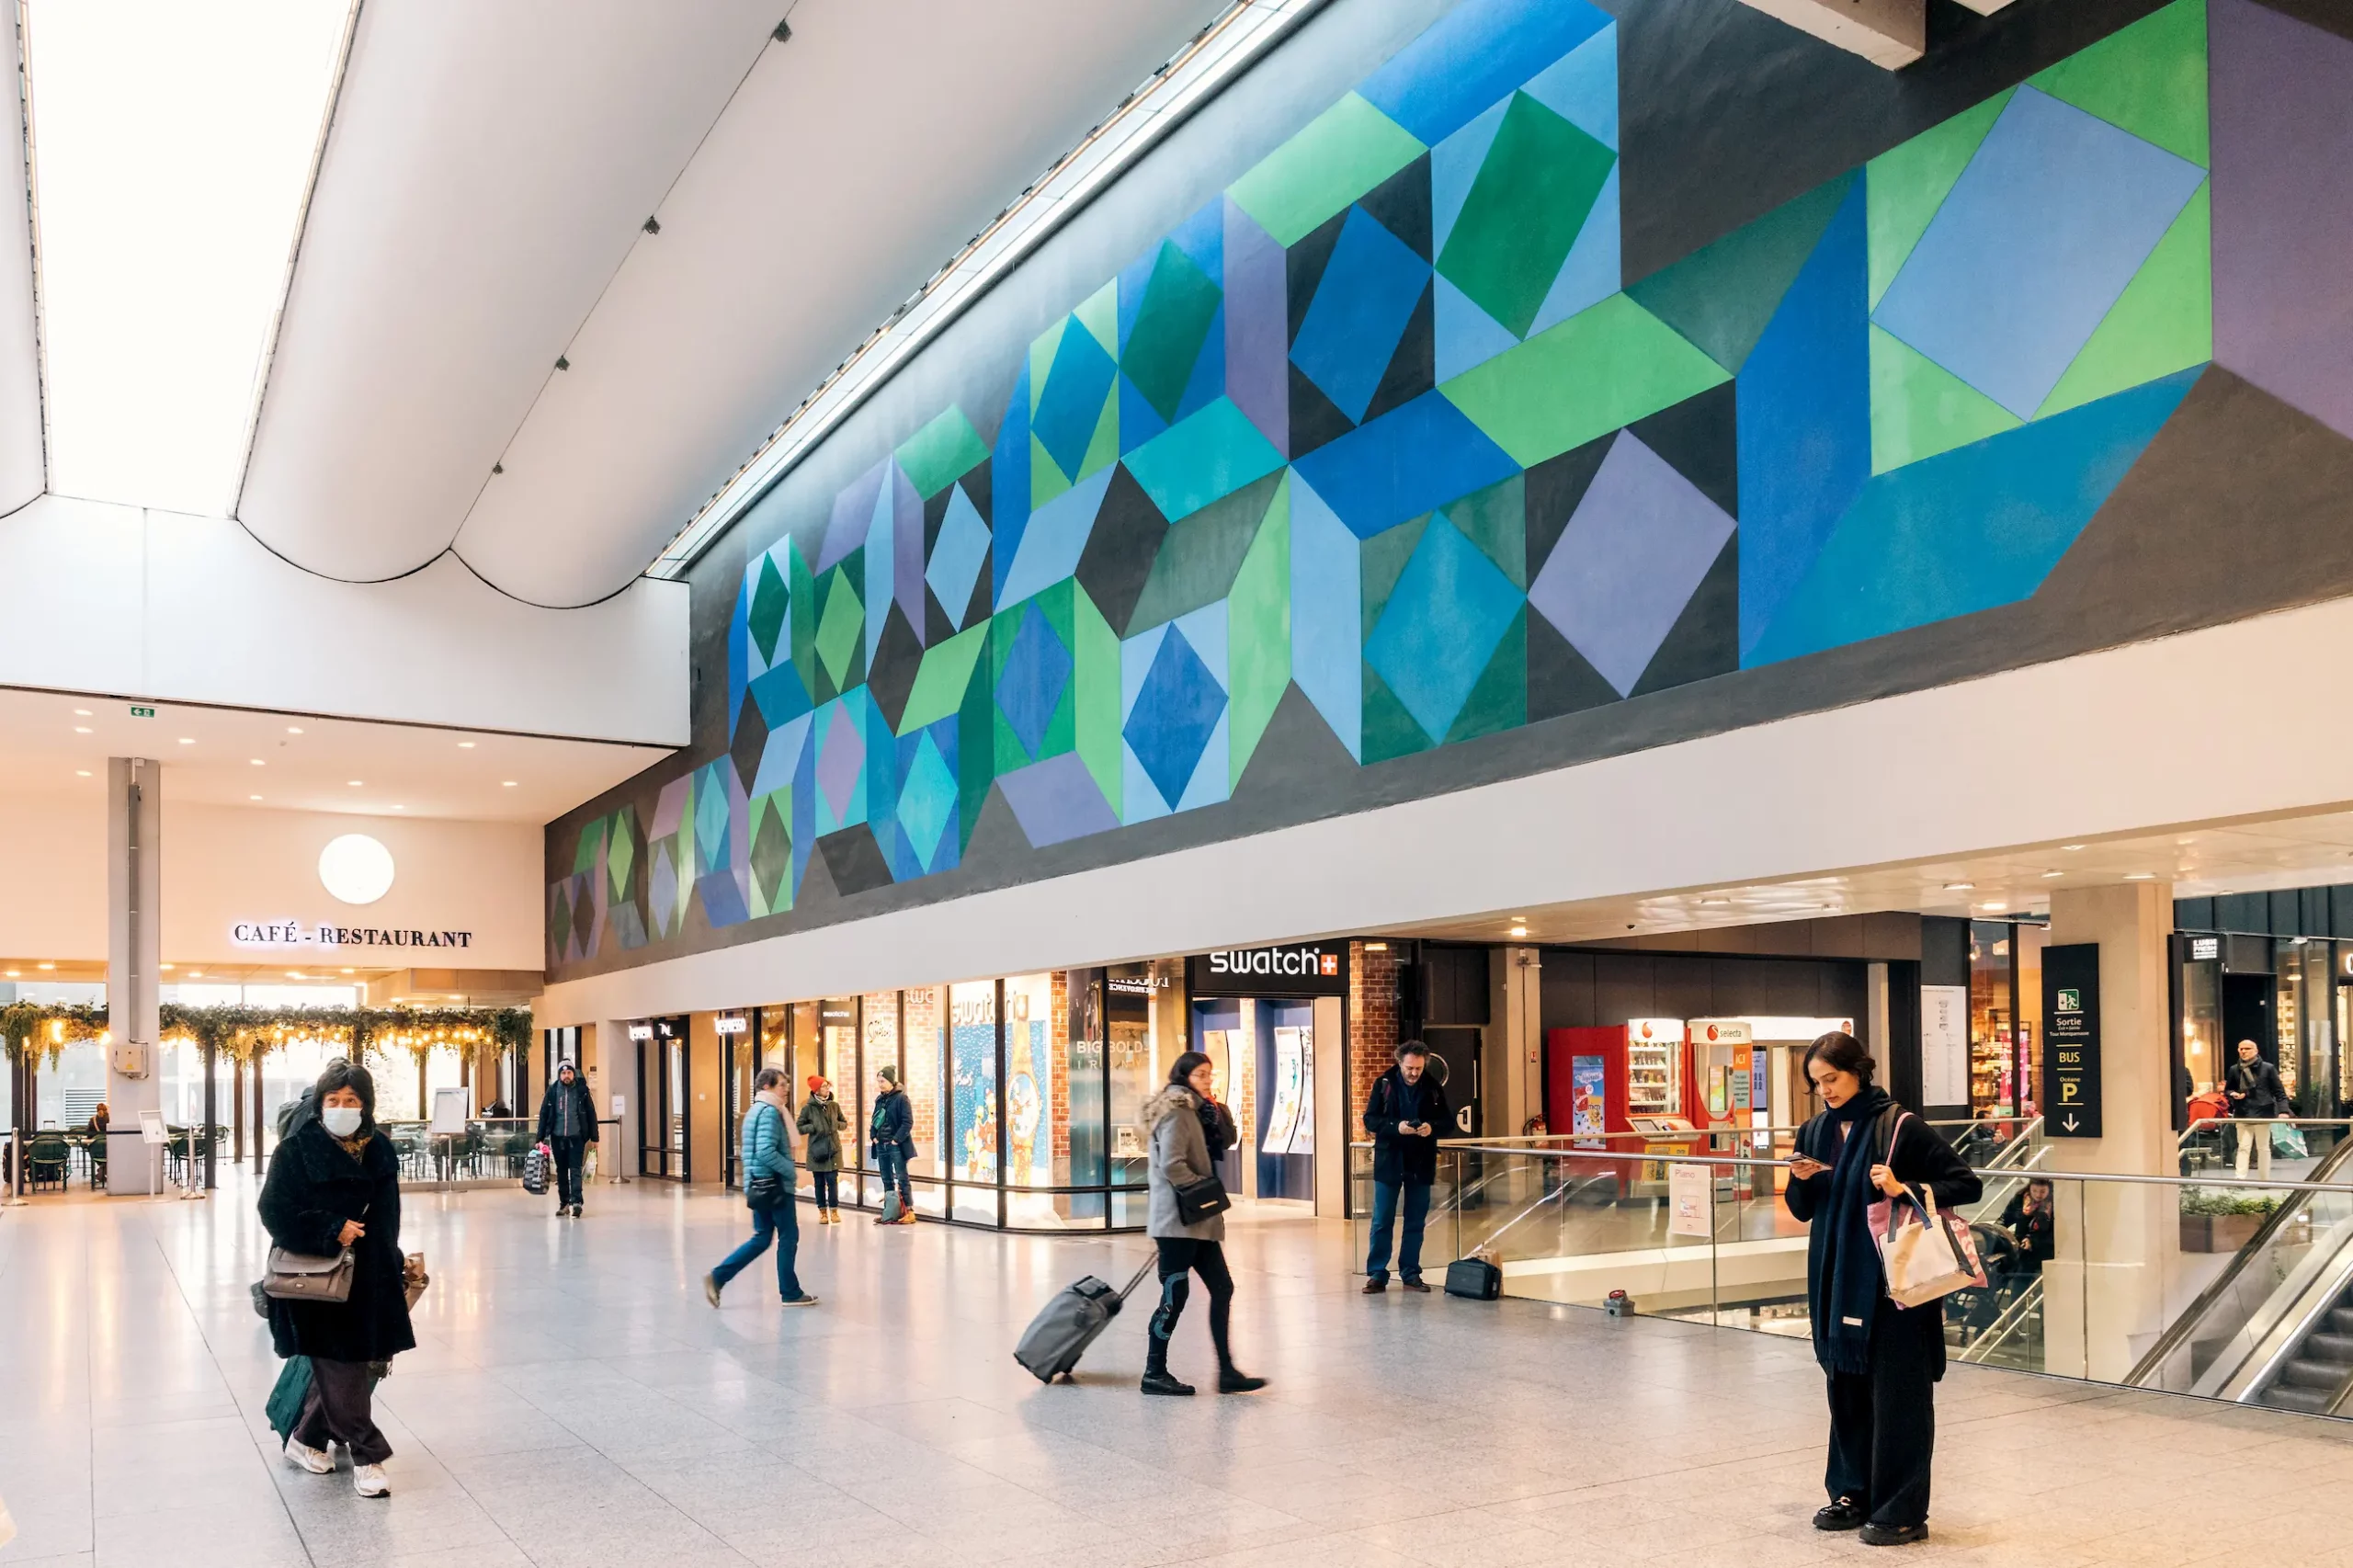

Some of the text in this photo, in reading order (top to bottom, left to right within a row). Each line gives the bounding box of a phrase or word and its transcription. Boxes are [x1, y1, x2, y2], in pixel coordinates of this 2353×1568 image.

[234, 921, 297, 943] CAFÉ
[319, 927, 472, 949] RESTAURANT
[1210, 948, 1319, 975] swatch
[2056, 1017, 2082, 1026] Sortie
[1720, 1029, 1742, 1038] selecta
[1076, 1040, 1103, 1054] BIG
[2059, 1051, 2080, 1062] BUS
[2062, 1083, 2077, 1103] P
[1675, 1168, 1696, 1179] Piano
